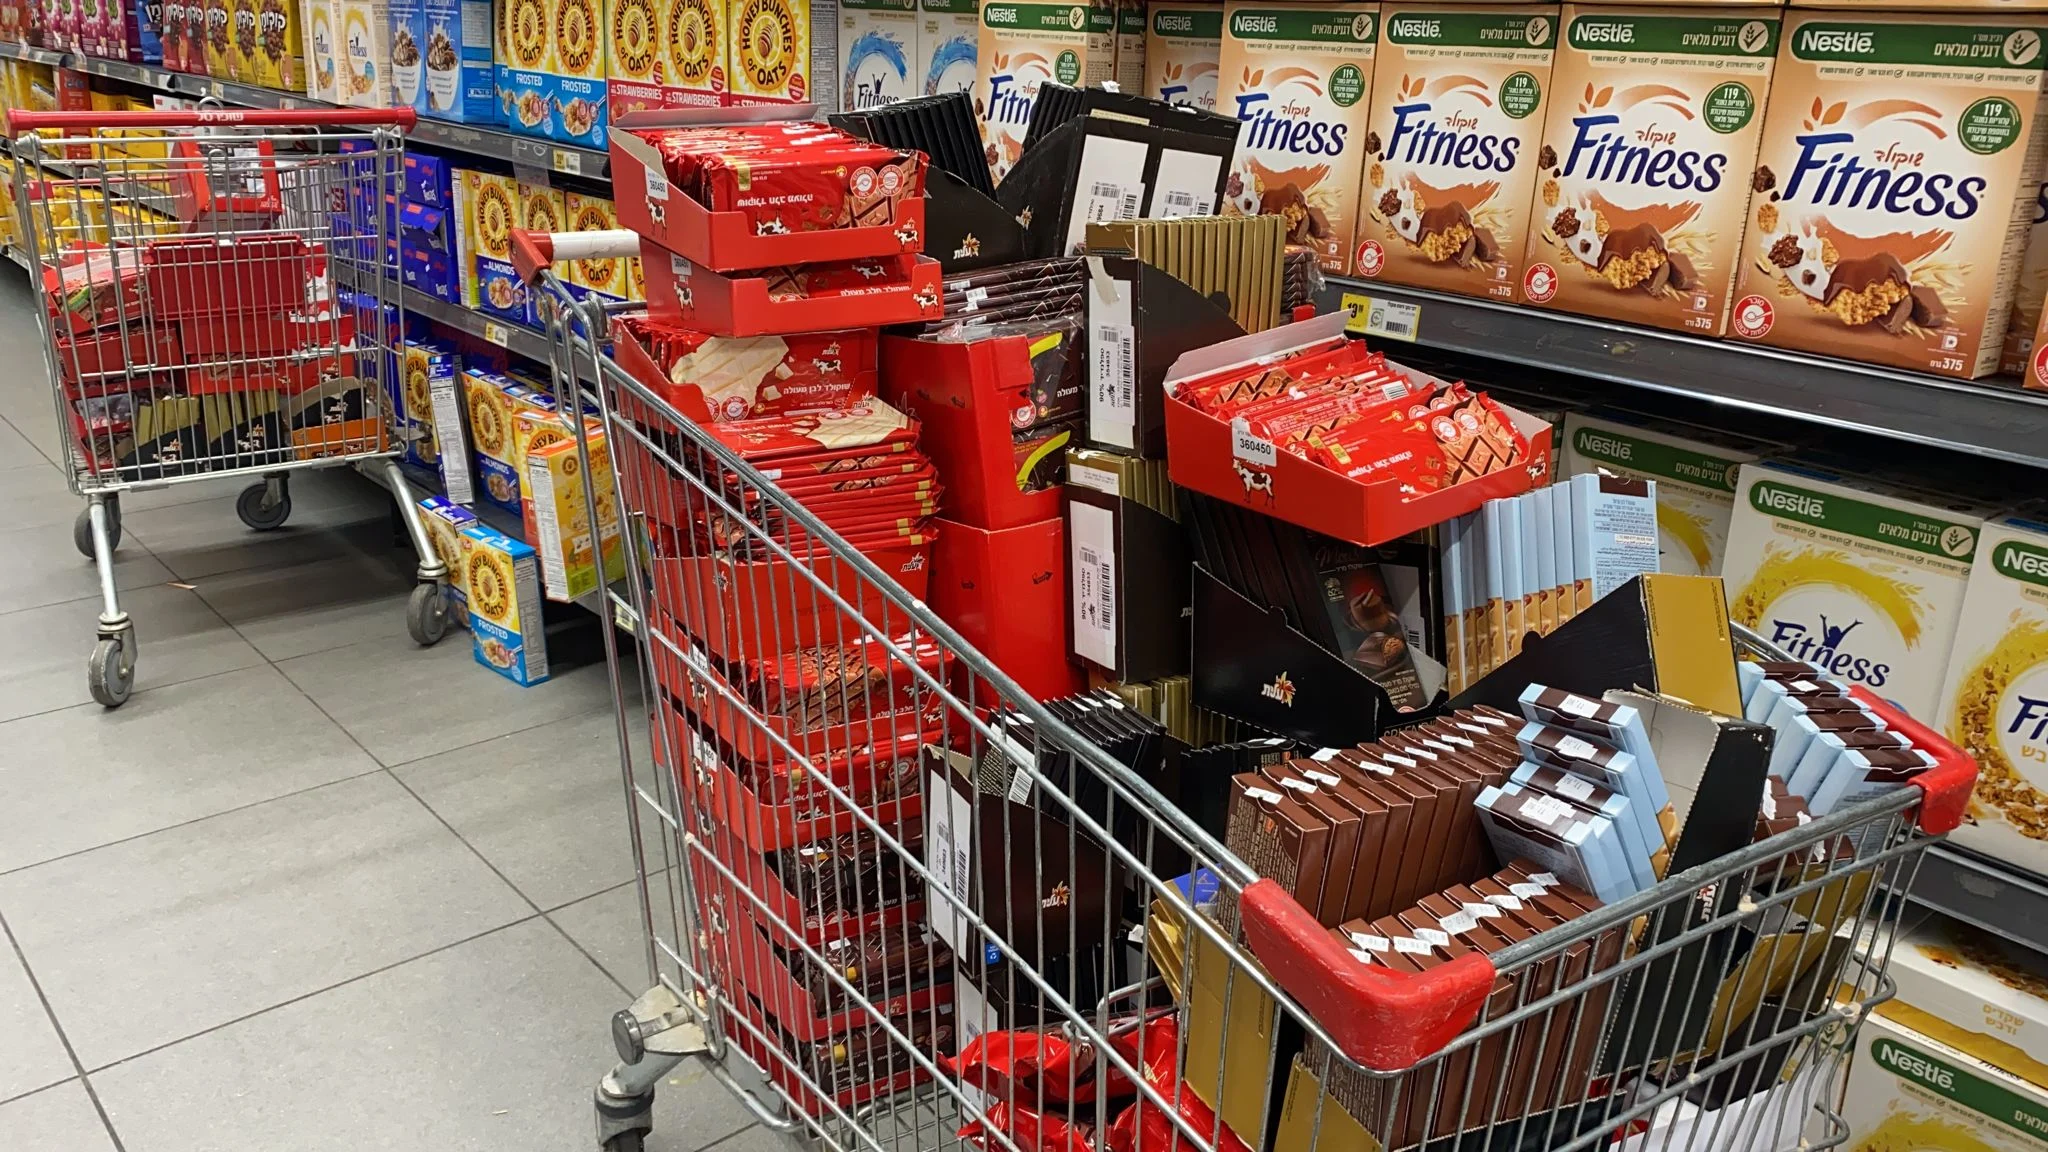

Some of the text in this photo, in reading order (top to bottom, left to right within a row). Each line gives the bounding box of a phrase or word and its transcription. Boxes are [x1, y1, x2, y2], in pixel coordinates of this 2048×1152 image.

[742, 0, 760, 50] HONEY
[762, 0, 792, 54] BUNCHES
[1234, 16, 1278, 32] Nestlé
[1312, 24, 1350, 35] דגנים מלאים
[1393, 20, 1442, 38] Nestlé
[1576, 22, 1635, 44] Nestlé
[671, 0, 685, 45] HONEY
[685, 55, 708, 78] OATS
[1480, 28, 1524, 40] דגנים מלאים
[1682, 34, 1735, 46] דגנים מלאים
[1800, 31, 1875, 54] Nestlé
[350, 39, 367, 57] Fitness
[523, 42, 540, 61] OATS
[1934, 43, 2001, 58] דגנים מלאים
[569, 48, 589, 68] OATS
[629, 50, 651, 71] OATS
[516, 73, 542, 86] FROSTED
[757, 61, 786, 86] OATS
[1343, 69, 1353, 78] 119
[1516, 77, 1527, 88] 119
[562, 80, 591, 94] FROSTED
[617, 84, 662, 100] STRAWBERRIES
[1724, 88, 1738, 99] 119
[672, 92, 720, 108] STRAWBERRIES
[1281, 99, 1310, 121] שוקולד
[1984, 104, 2002, 116] 119
[1236, 93, 1346, 156] Fitness
[1444, 110, 1478, 131] שוקולד
[1386, 103, 1520, 172] Fitness
[1636, 124, 1676, 148] שוקולד
[1562, 115, 1728, 192] Fitness
[1874, 142, 1924, 170] שוקולד
[1782, 134, 1986, 220] Fitness
[480, 190, 489, 224] HONEY
[490, 187, 510, 229] BUNCHES
[489, 262, 515, 276] ALMONDS
[589, 265, 610, 281] OATS
[1330, 260, 1342, 270] 375
[1498, 286, 1512, 296] 375
[1750, 297, 1764, 306] סוכר
[1695, 317, 1712, 328] 375
[1930, 357, 1963, 371] 375 גרם
[784, 383, 850, 395] שוקולד לבן מעולה
[1057, 386, 1078, 398] מעולה
[1240, 437, 1271, 456] 360450
[1580, 432, 1632, 461] Nestlé
[485, 457, 510, 474] ALMONDS
[1675, 462, 1724, 484] דגנים מלאים
[1758, 486, 1826, 520] Nestlé
[1878, 522, 1938, 547] דגנים מלאים
[2003, 547, 2048, 576] Nes
[471, 555, 504, 616] HONEY BUNCHES OATS
[478, 619, 508, 640] FROSTED
[1772, 618, 1890, 688] Fitness
[1262, 683, 1292, 700] עלית
[1983, 1004, 2024, 1027] שקדים
[1986, 1016, 2018, 1036] ודבש
[1880, 1044, 1956, 1092] Nestlé
